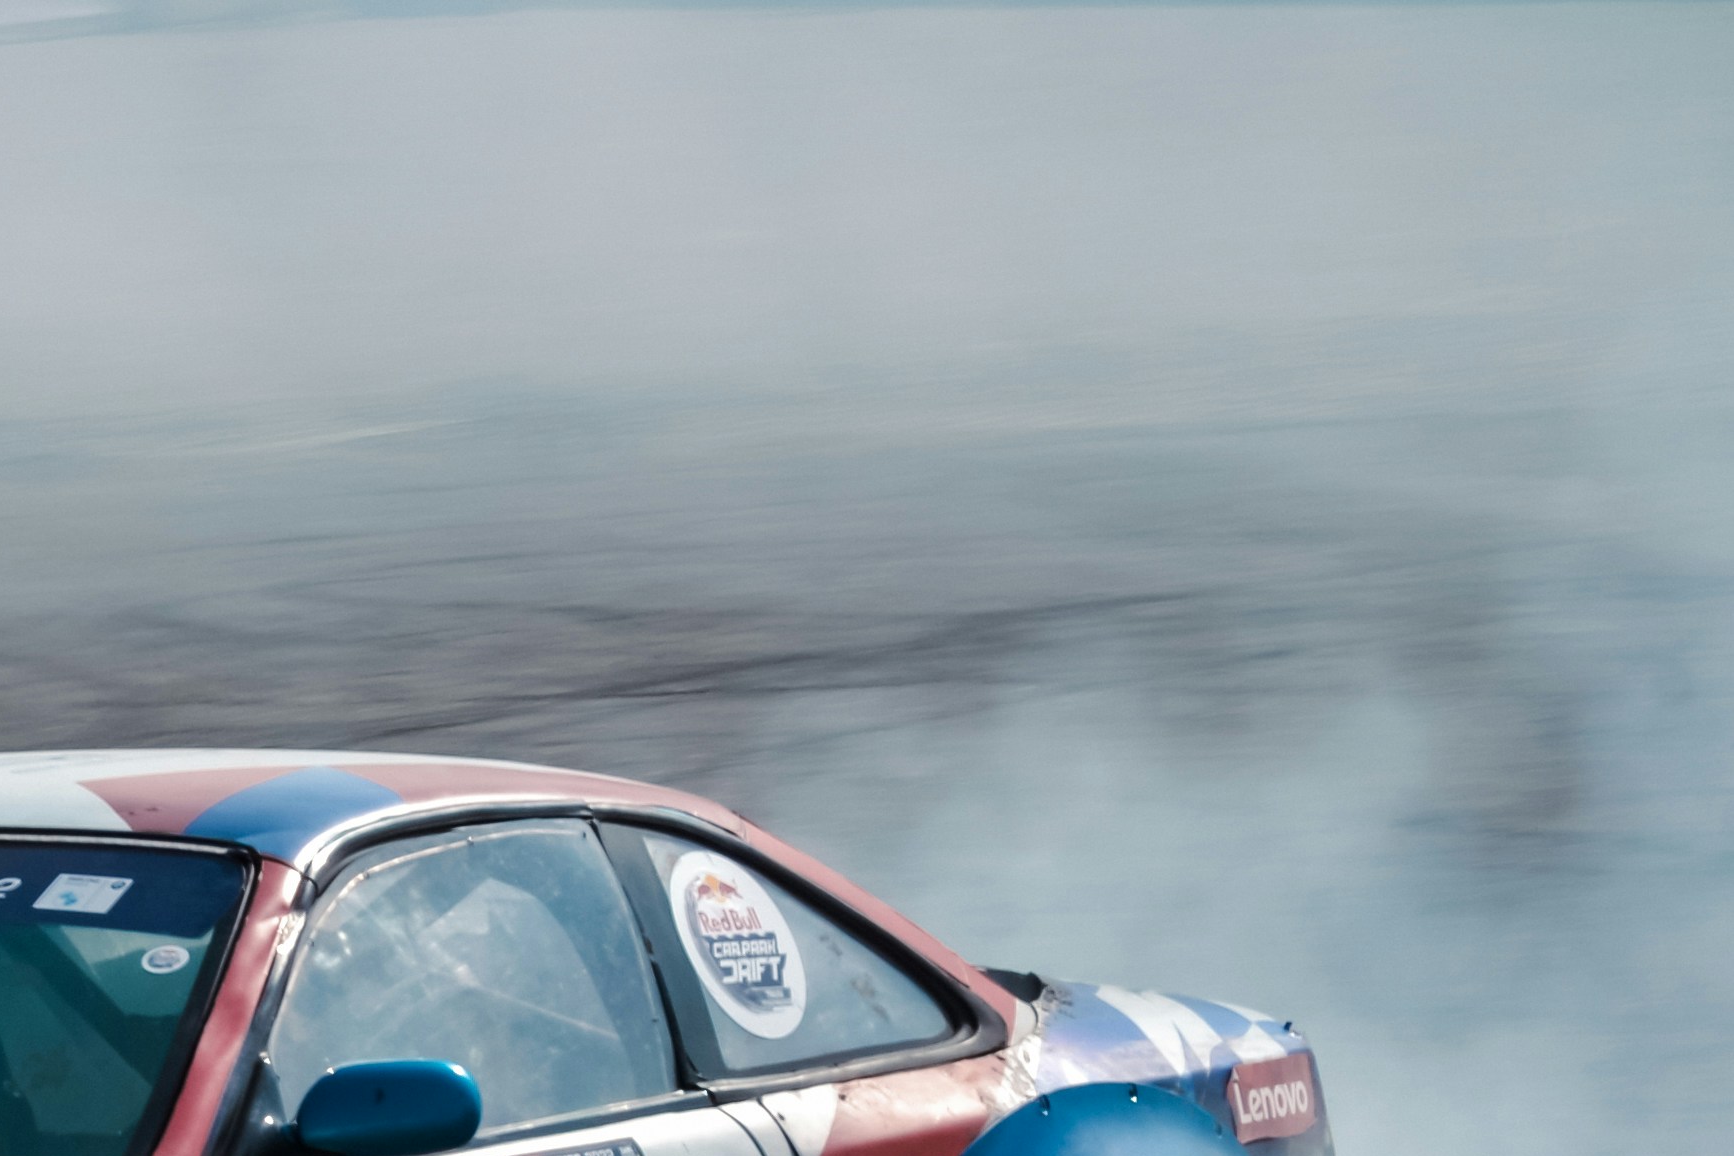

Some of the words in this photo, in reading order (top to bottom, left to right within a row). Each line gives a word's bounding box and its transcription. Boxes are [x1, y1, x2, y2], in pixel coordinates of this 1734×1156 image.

[698, 909, 732, 934] Red
[733, 906, 762, 931] Bull
[712, 940, 742, 958] CAR
[719, 956, 782, 984] DRIFT
[1233, 1080, 1308, 1124] Lenovo
